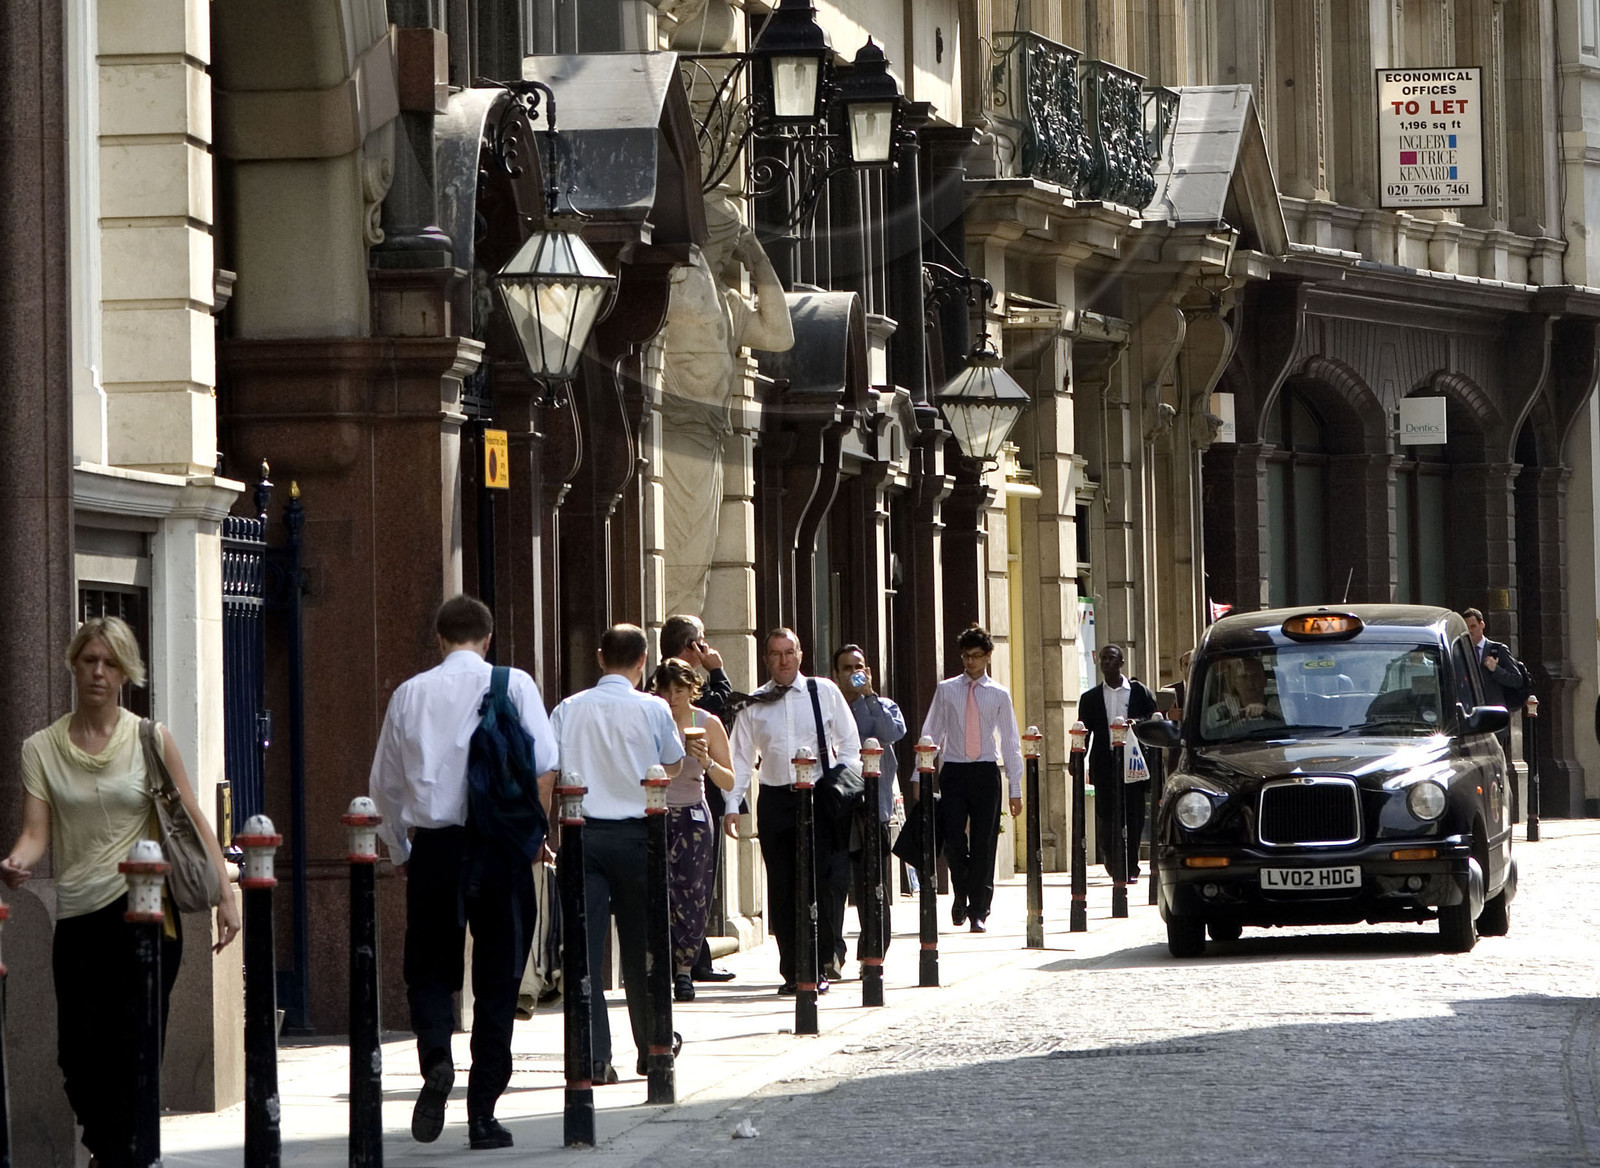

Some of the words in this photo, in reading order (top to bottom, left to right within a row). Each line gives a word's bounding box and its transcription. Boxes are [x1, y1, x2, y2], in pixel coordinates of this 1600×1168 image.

[1385, 72, 1473, 82] ECONOMICAL
[1402, 85, 1457, 96] OFFICES
[1391, 101, 1420, 115] TO
[1430, 100, 1468, 115] LET
[1400, 121, 1427, 131] 1,196
[1432, 122, 1446, 130] sq
[1451, 120, 1461, 129] ft
[1400, 135, 1448, 149] INGLEBY
[1418, 150, 1457, 165] TRICE
[1400, 166, 1449, 181] KENNARD
[1387, 184, 1408, 196] 020
[1414, 184, 1441, 195] 7606
[1446, 183, 1470, 195] 7461
[1406, 423, 1440, 433] Dentics
[1301, 618, 1345, 632] TAXI
[1267, 870, 1314, 886] LV02
[1319, 869, 1354, 885] HDG
